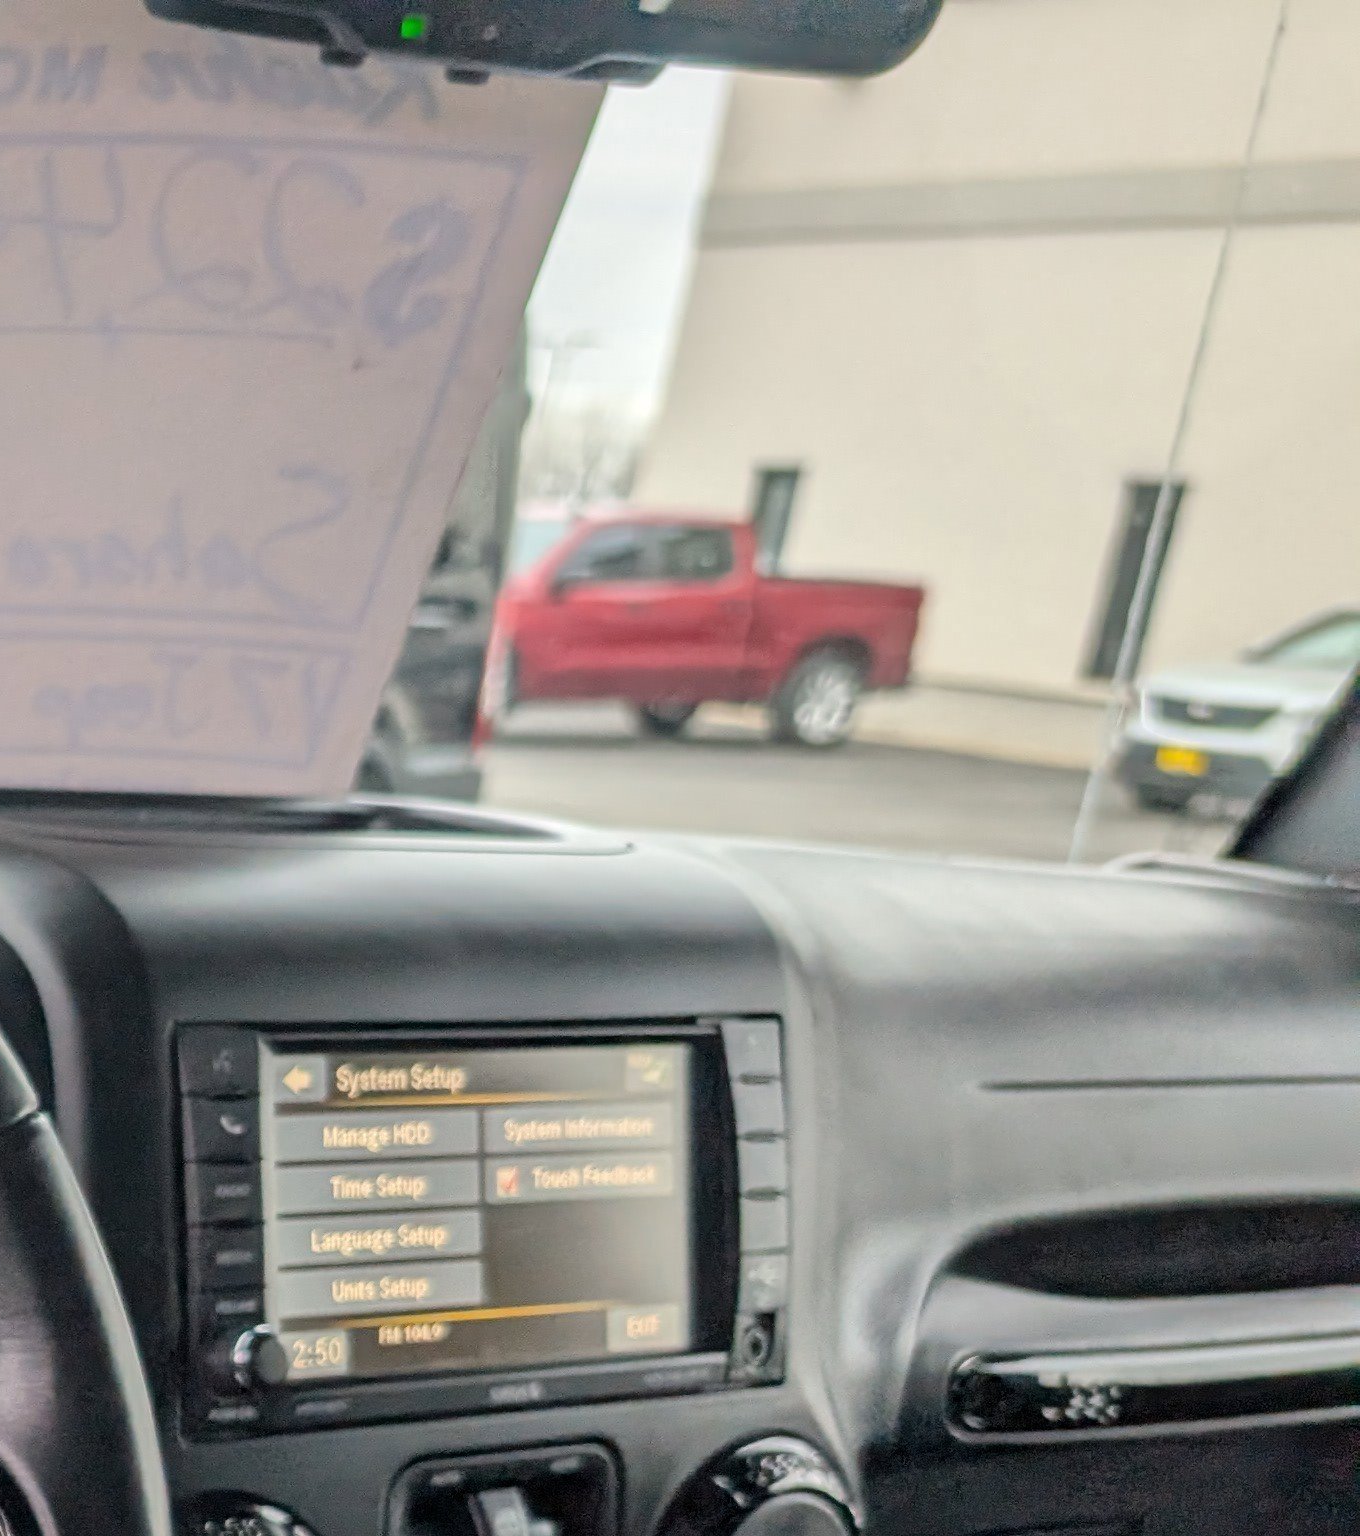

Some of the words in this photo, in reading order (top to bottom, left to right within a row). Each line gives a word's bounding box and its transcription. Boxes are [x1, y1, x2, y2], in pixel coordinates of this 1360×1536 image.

[336, 1063, 408, 1098] System
[411, 1062, 467, 1094] Setup
[323, 1125, 391, 1152] Manage
[393, 1121, 432, 1145] HDD
[504, 1119, 561, 1145] System
[564, 1117, 654, 1139] Information
[330, 1174, 374, 1199] Time
[376, 1173, 427, 1200] Setup
[533, 1166, 580, 1189] Touch
[583, 1164, 656, 1185] Feedback
[311, 1228, 395, 1256] Language
[397, 1224, 448, 1249] Setup
[332, 1278, 375, 1303] Units
[379, 1275, 430, 1301] Setup
[293, 1336, 341, 1369] 2:50
